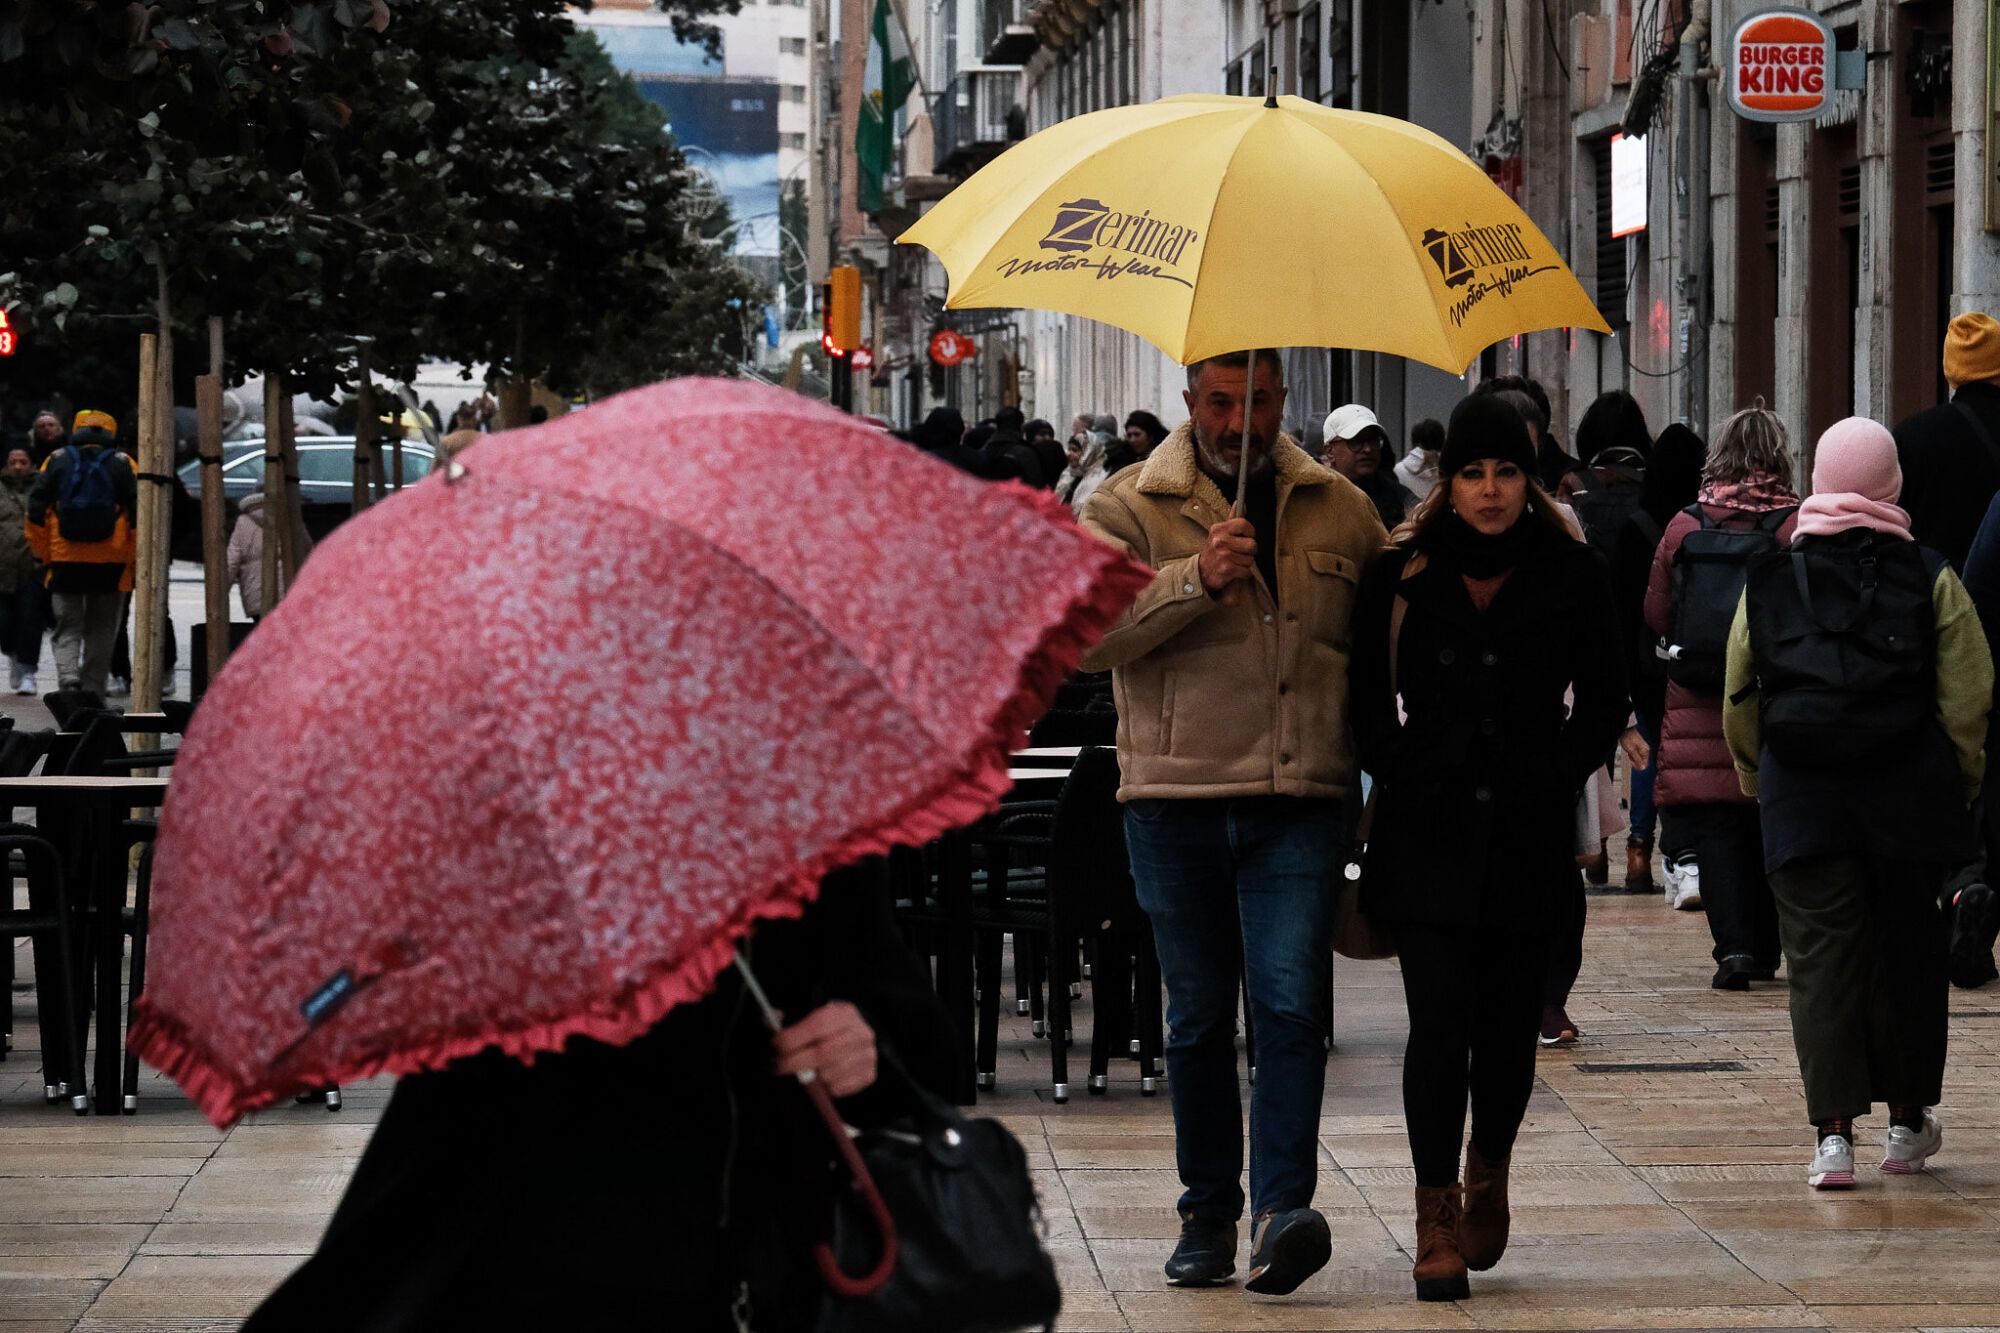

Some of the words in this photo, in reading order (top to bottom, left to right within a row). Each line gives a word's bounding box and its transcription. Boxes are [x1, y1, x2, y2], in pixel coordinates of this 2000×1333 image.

[1739, 46, 1824, 65] BURGER
[1739, 66, 1824, 93] KING
[1039, 198, 1198, 267] Zerimar
[1421, 221, 1533, 290] Zerimar
